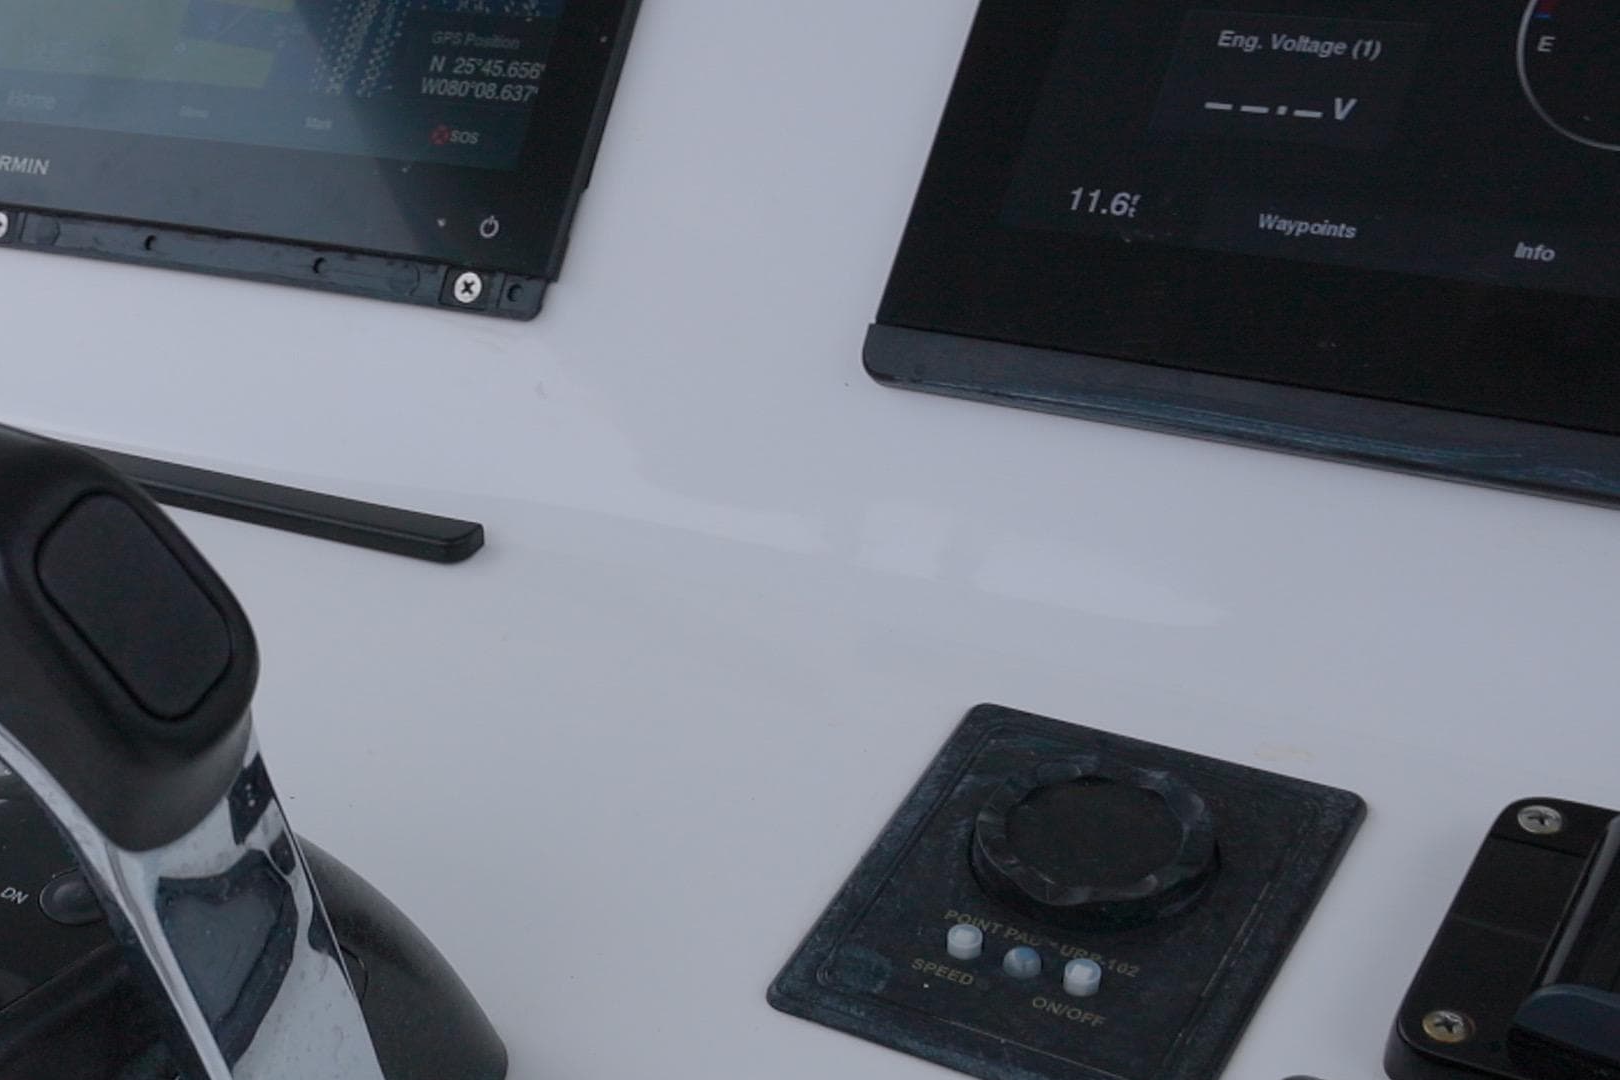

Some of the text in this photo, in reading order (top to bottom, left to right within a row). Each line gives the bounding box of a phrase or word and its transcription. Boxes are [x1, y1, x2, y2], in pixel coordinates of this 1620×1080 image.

[431, 31, 541, 50] GPS Position
[1217, 30, 1382, 61] Eng. Voltage (1)
[1537, 35, 1556, 52] E
[429, 55, 446, 73] N
[450, 129, 480, 145] SOS
[1257, 212, 1357, 240] Waypoints
[1513, 240, 1557, 262] Info
[0, 886, 29, 905] DN
[910, 957, 975, 986] SPEED
[1031, 996, 1108, 1028] ON/OFF
